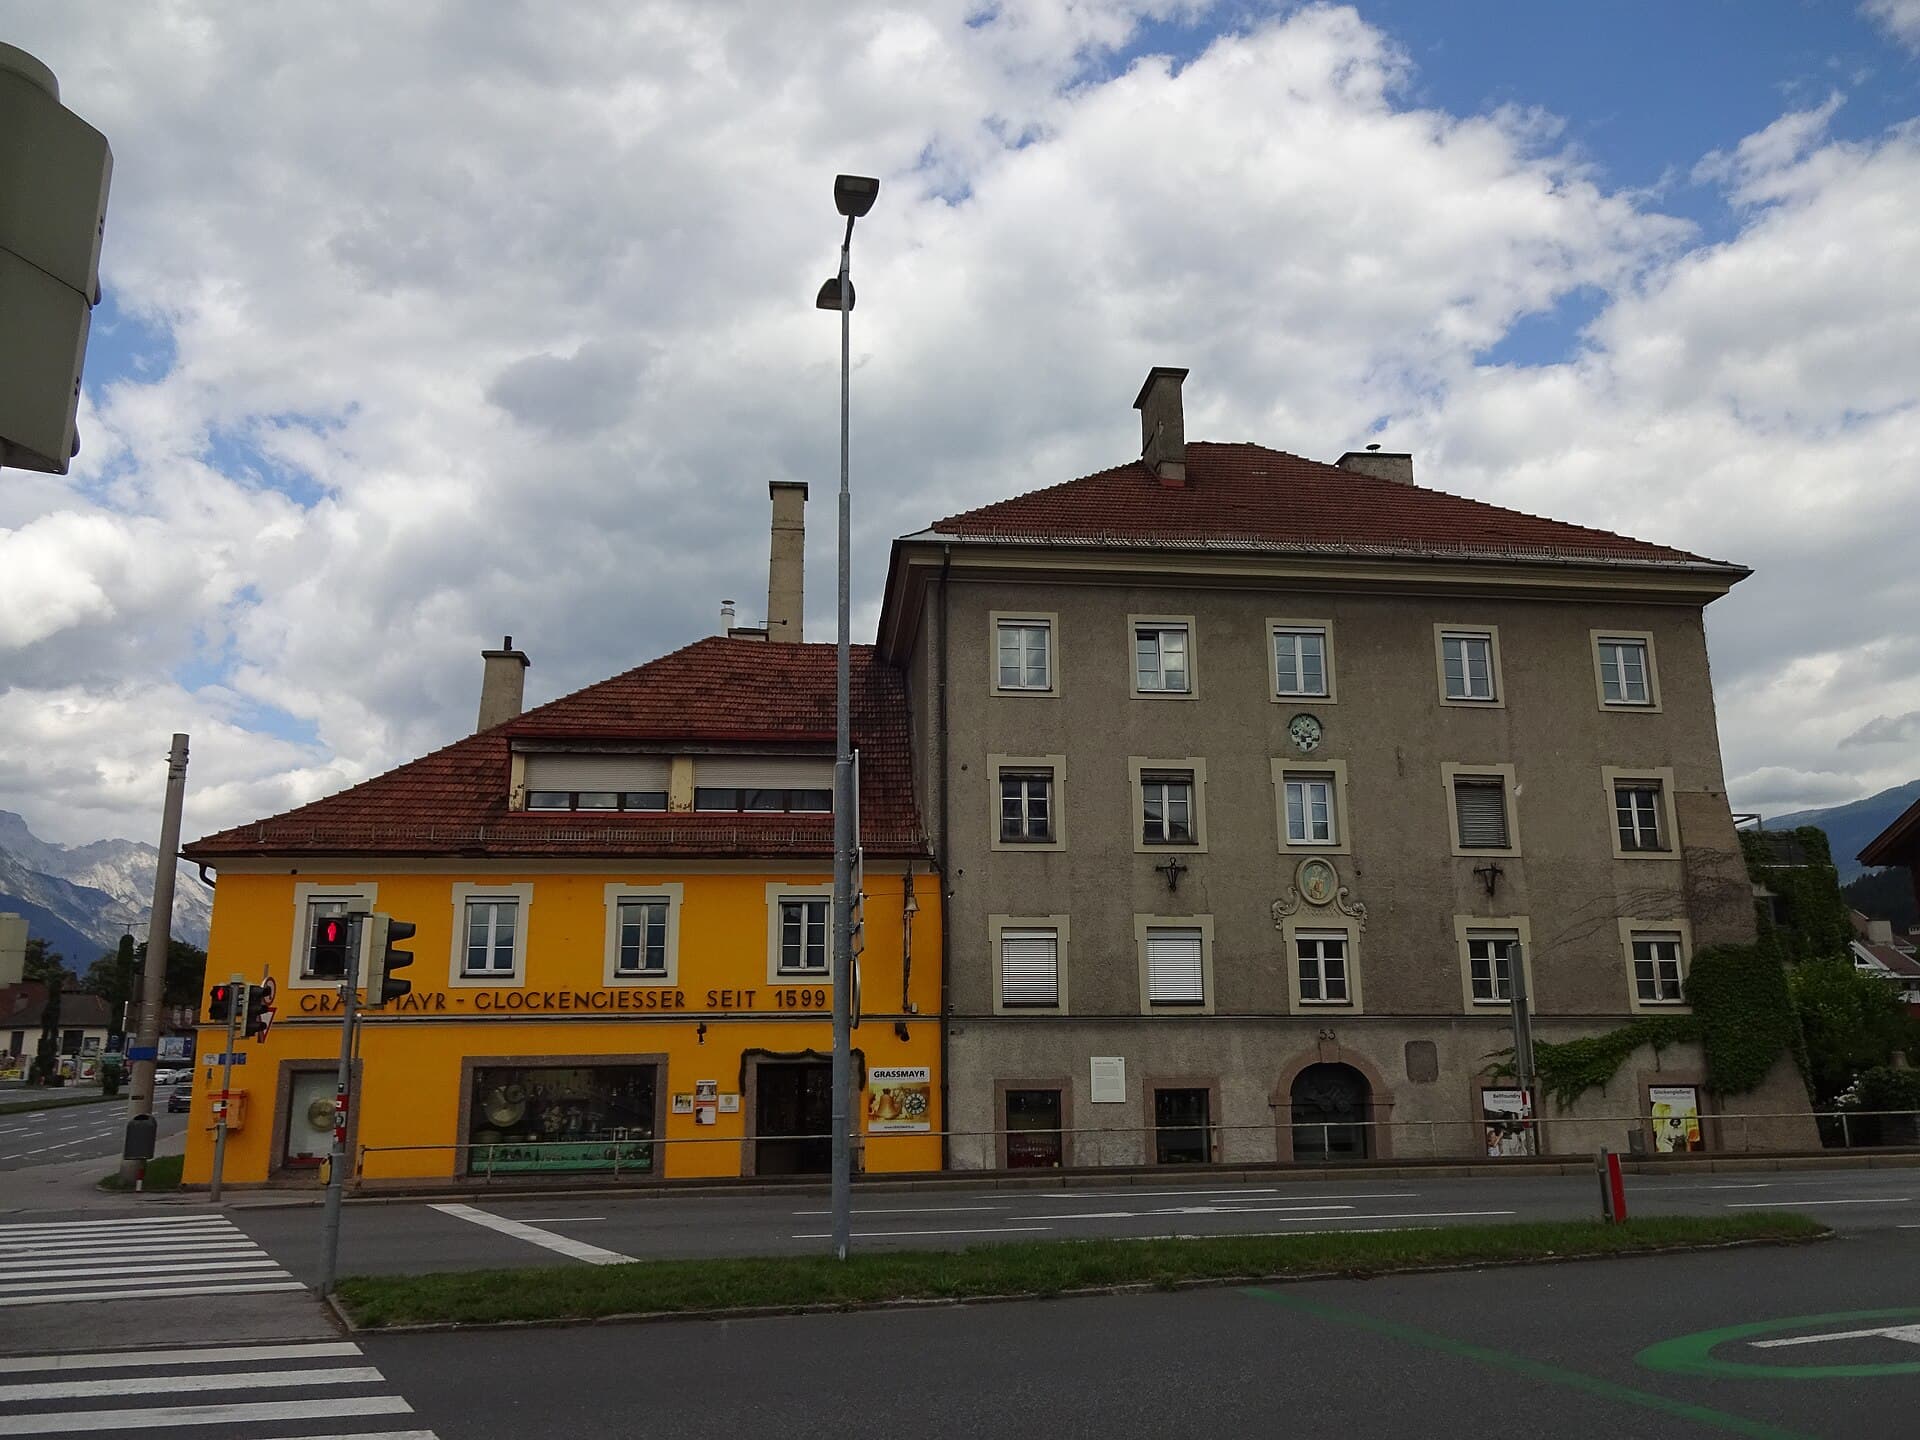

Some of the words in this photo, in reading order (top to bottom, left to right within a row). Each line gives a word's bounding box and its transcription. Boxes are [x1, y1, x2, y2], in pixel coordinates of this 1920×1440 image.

[475, 991, 685, 1009] GLOCKENGIESSER
[706, 990, 756, 1008] SEIT
[775, 989, 826, 1007] 1599
[1319, 1029, 1336, 1040] 53
[874, 1070, 925, 1078] GRASSMAYR
